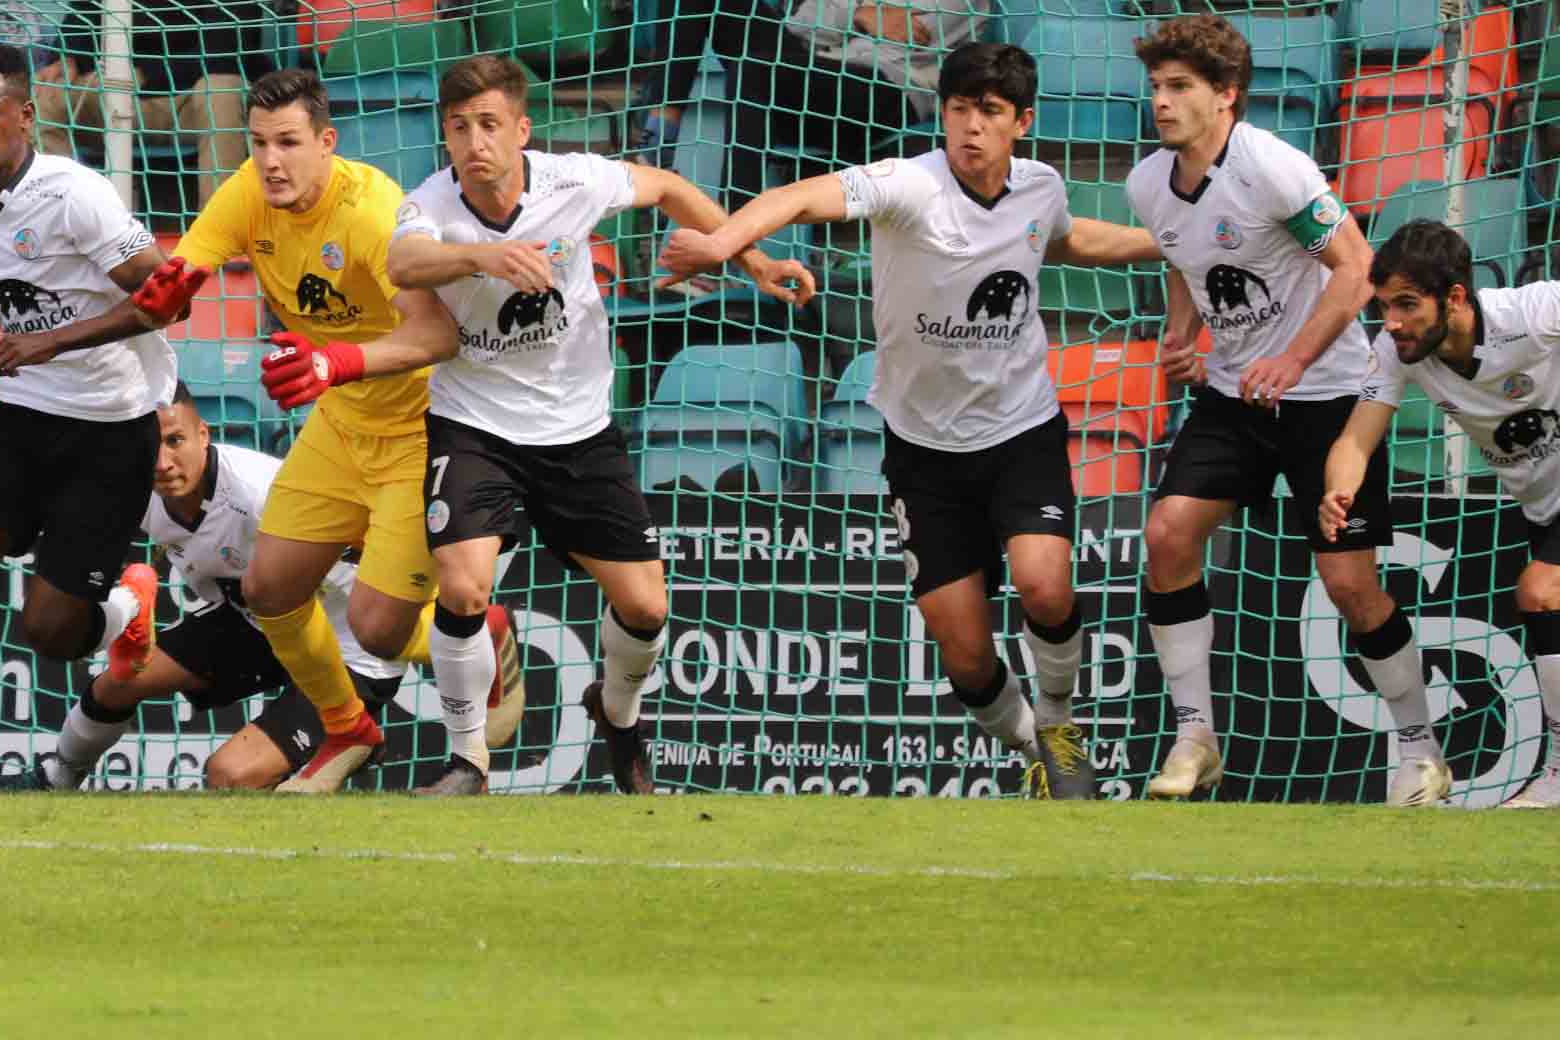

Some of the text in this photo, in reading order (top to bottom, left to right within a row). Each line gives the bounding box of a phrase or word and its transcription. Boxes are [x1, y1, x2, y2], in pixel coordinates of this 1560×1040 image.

[431, 455, 450, 497] 7
[718, 743, 746, 766] DE
[882, 735, 927, 768] 163
[952, 735, 1131, 769] SALACA
